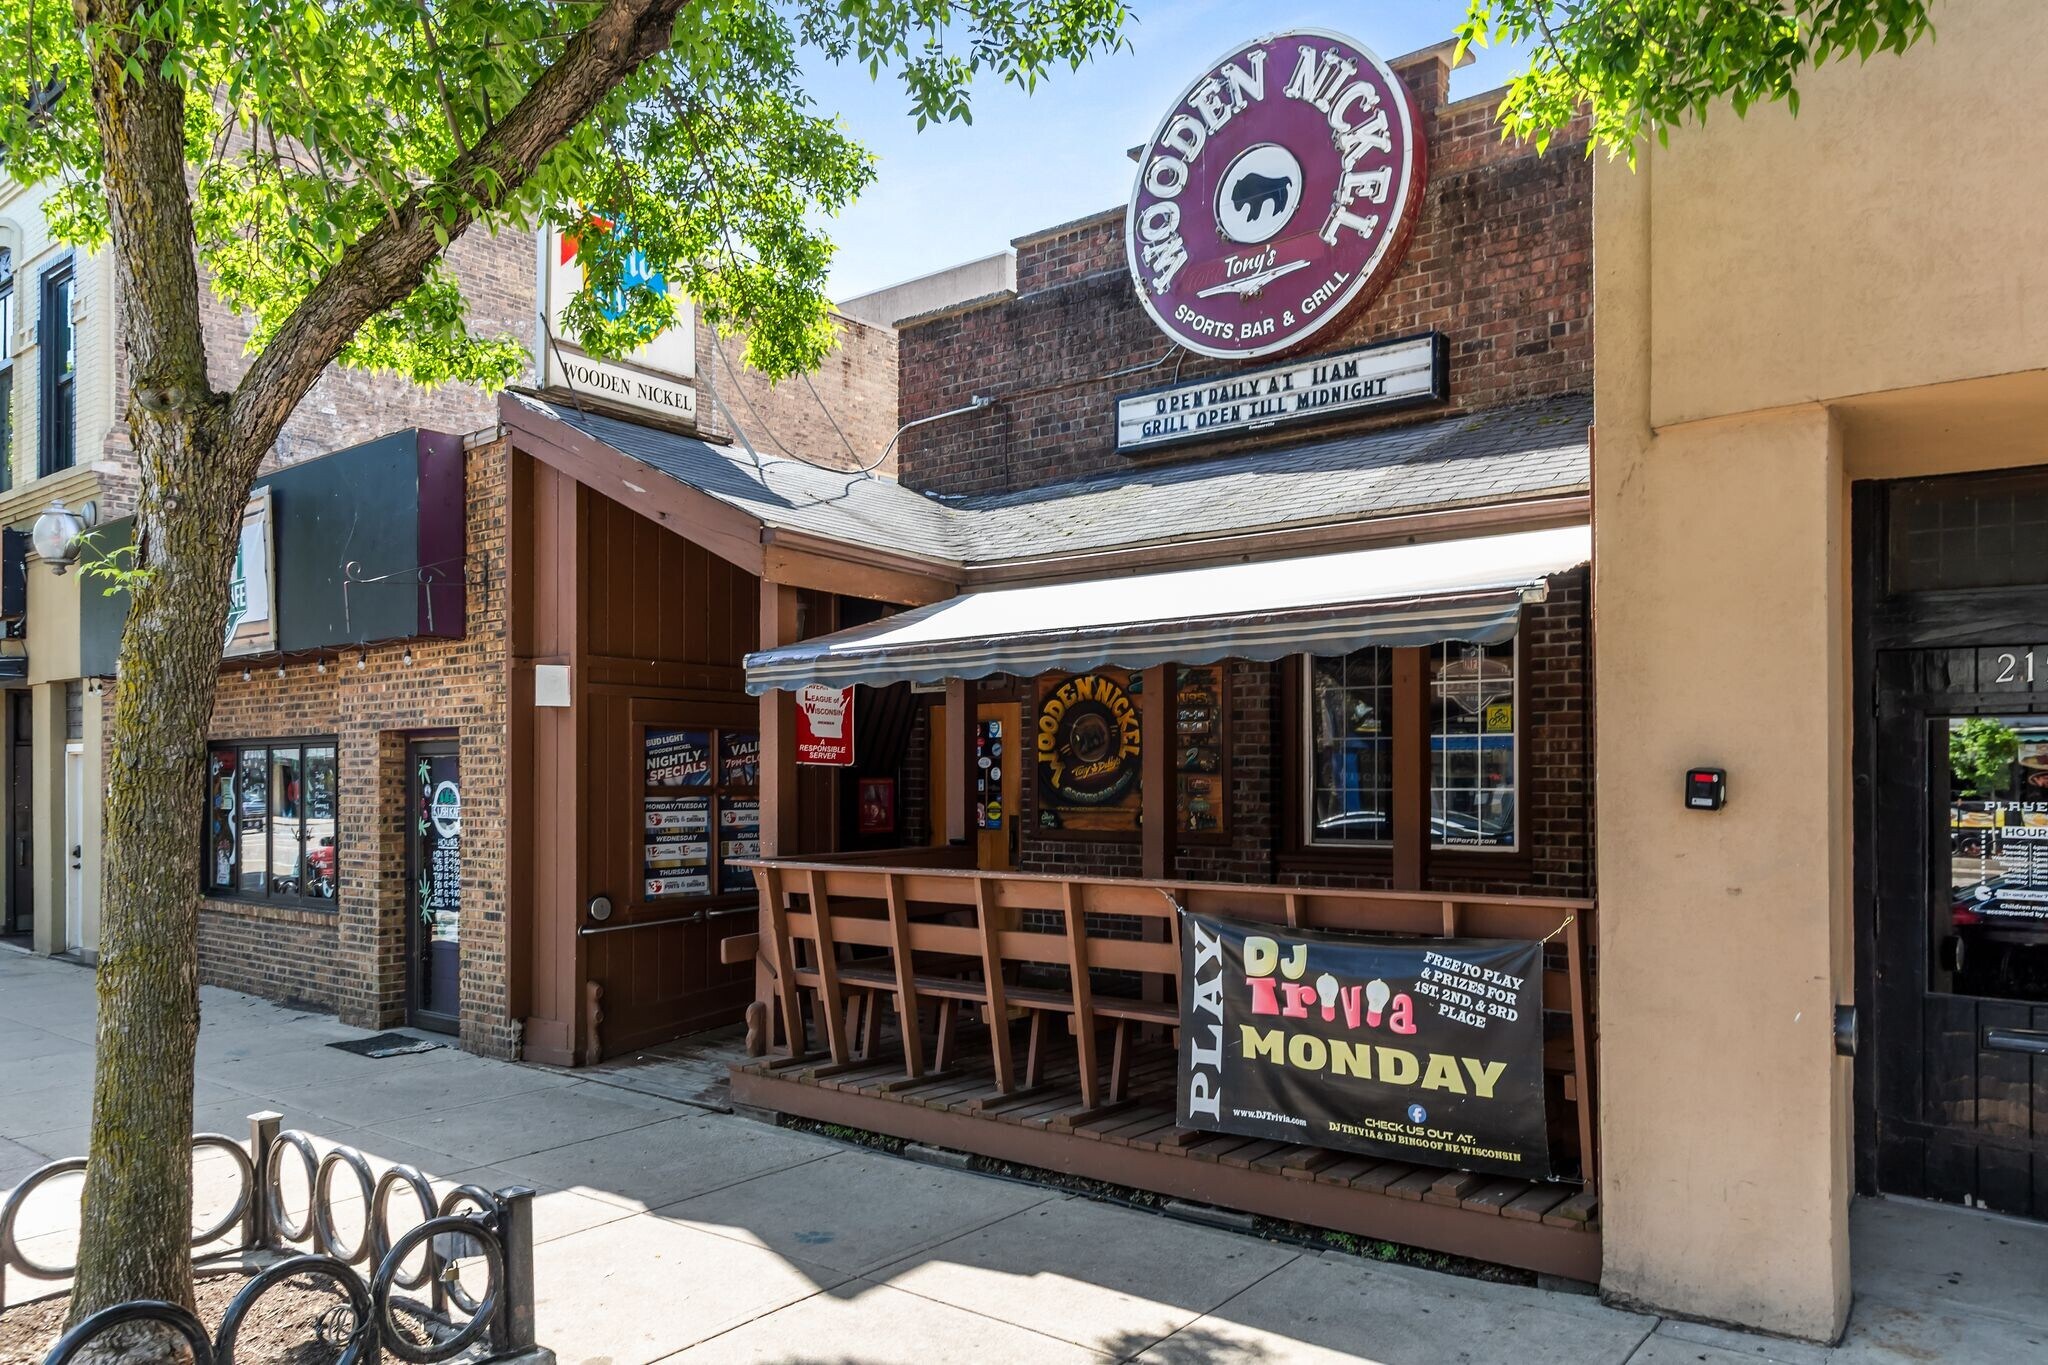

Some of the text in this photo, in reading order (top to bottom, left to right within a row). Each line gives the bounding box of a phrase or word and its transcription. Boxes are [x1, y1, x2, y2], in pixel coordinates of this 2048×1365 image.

[1136, 45, 1392, 295] WOODEN NICKEL
[1224, 244, 1277, 278] Tony's
[1174, 271, 1350, 339] SPORTS BAR & GRILL
[563, 362, 692, 412] WOODEN NICKEL
[1156, 391, 1203, 415] OPEN
[1208, 380, 1260, 405] DAILY
[1312, 360, 1359, 386] 11AM
[1142, 415, 1189, 438] GRILL
[1197, 405, 1241, 428] OPEN
[1296, 378, 1387, 407] MIDNIGHT
[1996, 651, 2048, 683] 21
[805, 690, 832, 703] LEAGUE
[805, 703, 843, 716] WISCONSIN
[646, 733, 684, 747] BUD LIGHT
[820, 738, 826, 746] A
[1038, 675, 1140, 789] WOODEN NICKEL
[646, 750, 702, 769] NIGHTLY
[731, 741, 760, 756] VALI
[799, 744, 846, 754] RESPONSIBLE
[809, 751, 837, 760] SERVER
[649, 761, 707, 781] SPECIALS
[646, 802, 708, 810] MONDAY/TUESDAY
[656, 834, 698, 842] WEDNESDAY
[659, 868, 695, 876] THURSDAY
[1243, 936, 1307, 980] DJ
[1423, 951, 1524, 990] FREE TO PLAY
[1414, 981, 1518, 1022] 1ST, 2ND, & 3RD
[1421, 967, 1517, 1006] & PRIZES FOR
[1245, 973, 1417, 1035] Trivia
[1438, 1004, 1487, 1028] PLACE
[1189, 920, 1223, 1123] PLAY
[1239, 1024, 1507, 1098] MONDAY
[1233, 1108, 1307, 1127] www.DJTrivia.com
[1365, 1118, 1476, 1145] CHECK US OUT AT:
[1329, 1122, 1340, 1132] DJ
[1341, 1124, 1376, 1139] TRIVIA
[1376, 1131, 1384, 1140] &
[1384, 1133, 1396, 1143] DJ
[1398, 1135, 1429, 1148] BINGO
[1461, 1145, 1521, 1162] WISCONSIN
